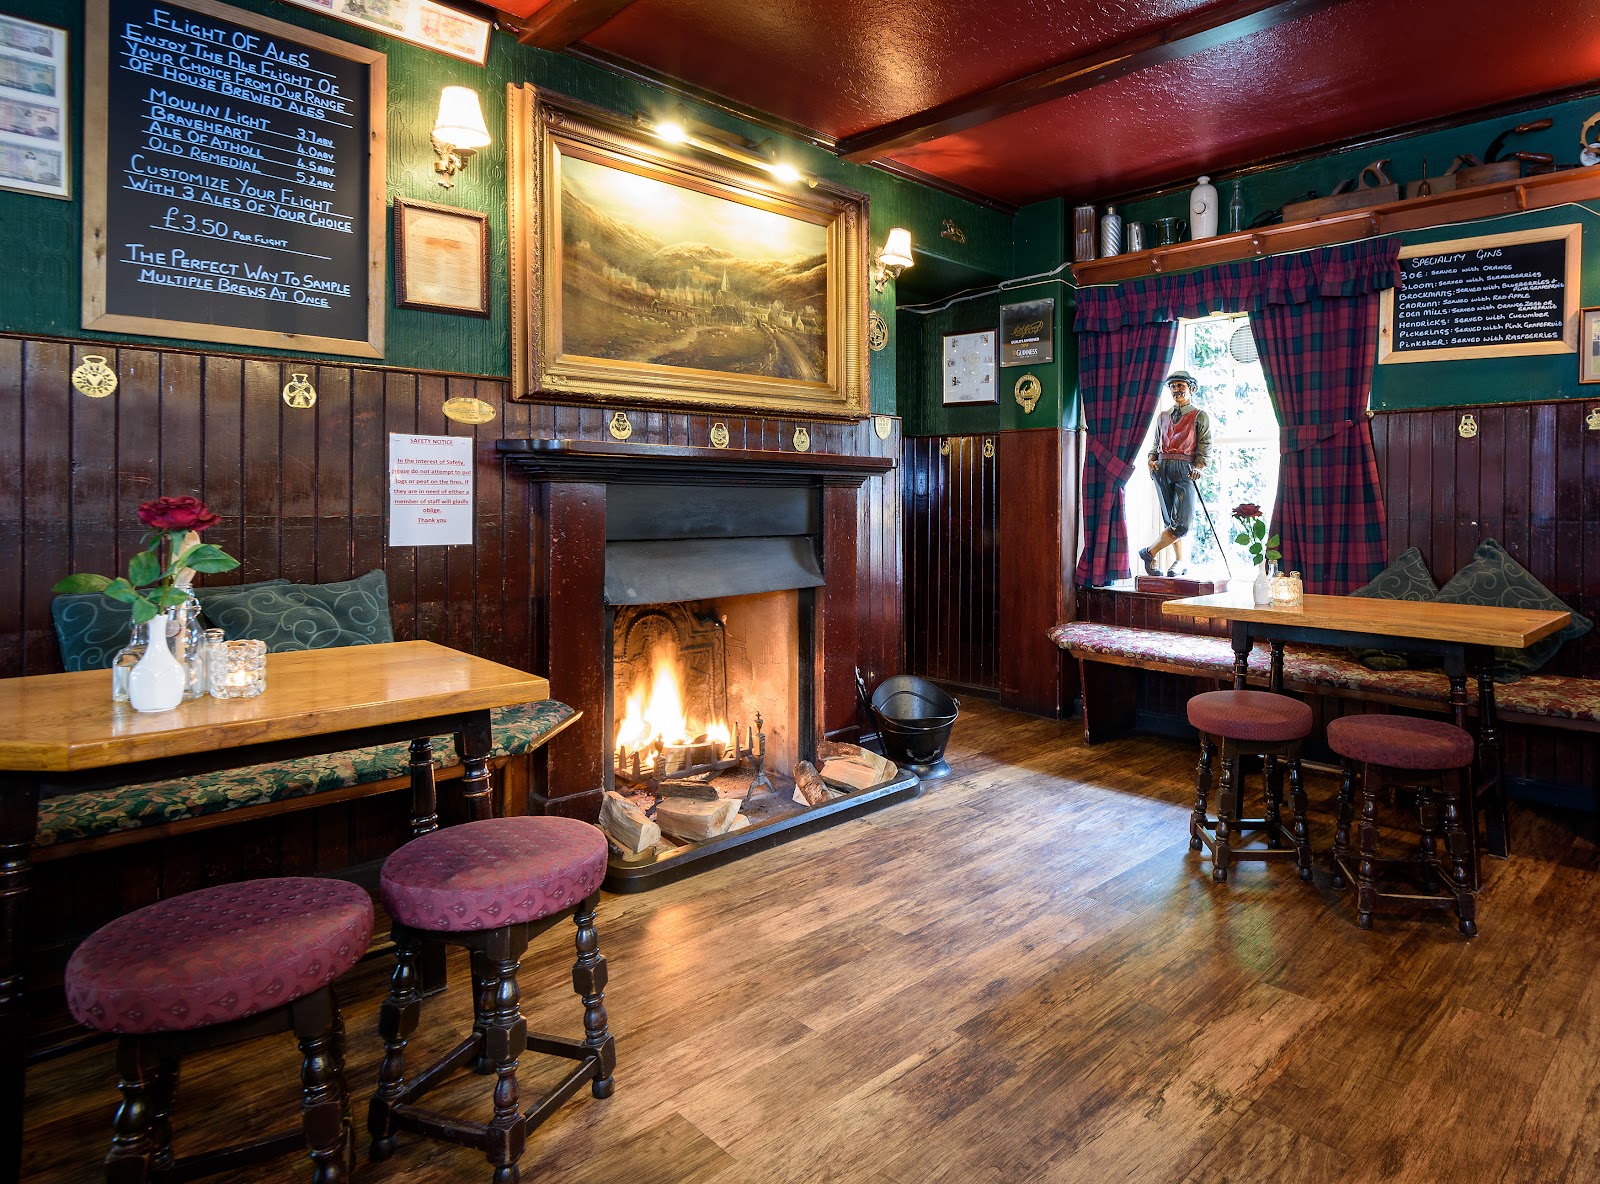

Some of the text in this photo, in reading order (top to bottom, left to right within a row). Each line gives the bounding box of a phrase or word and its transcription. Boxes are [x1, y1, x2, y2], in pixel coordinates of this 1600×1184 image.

[126, 23, 340, 95] ENJOY THE ALE FLiGHT OF
[154, 9, 310, 68] FLiGHT OF ALES
[126, 40, 346, 113] YOUR CHOiCE FROM OUR RANGE
[129, 57, 326, 119] OF HOUSE BREWED ALES
[150, 88, 219, 117] MOULIN
[224, 107, 271, 130] LiGHT
[151, 106, 253, 140] BRAVEHEART
[149, 121, 181, 140] ALE
[188, 130, 208, 143] OF
[210, 136, 264, 159] ATHOLL
[149, 136, 183, 154] OLD
[190, 146, 261, 174] REMEDiAL
[128, 175, 352, 232] WiTH 3 ALES OF YOUR CHOICE
[130, 154, 333, 213] CUSTOMIZE YOUR FLiGHT
[162, 206, 229, 237] £3.50
[254, 234, 288, 247] FLIGHT
[125, 243, 351, 294] THE PERFECT WAY TO SAMPLE
[1411, 249, 1502, 268] SPECIALITY GINS
[141, 268, 329, 307] MULTIPLE BREWS AT ONCE
